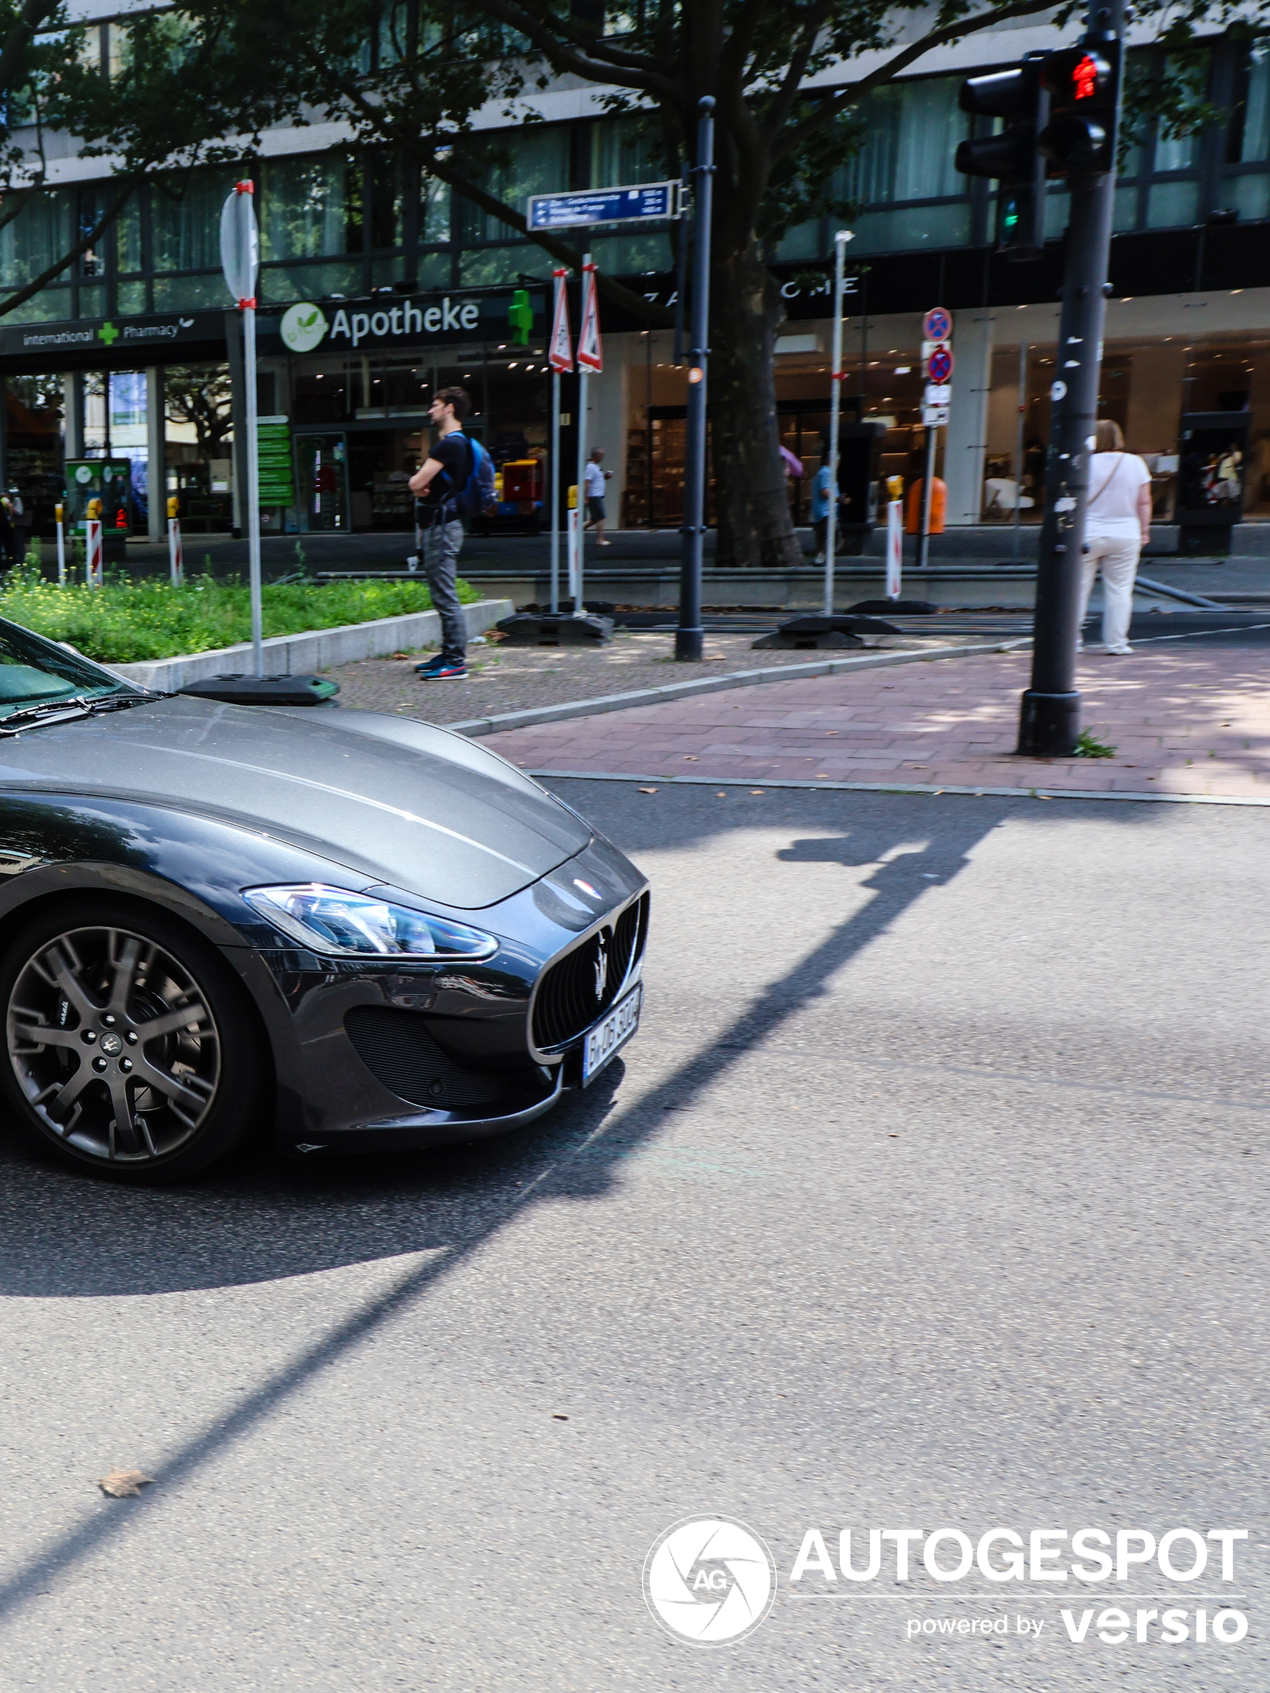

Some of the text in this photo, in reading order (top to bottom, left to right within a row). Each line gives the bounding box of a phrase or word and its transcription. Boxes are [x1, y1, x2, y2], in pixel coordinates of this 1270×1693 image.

[23, 324, 180, 346] international Pharmacy
[330, 297, 479, 347] Apotheke
